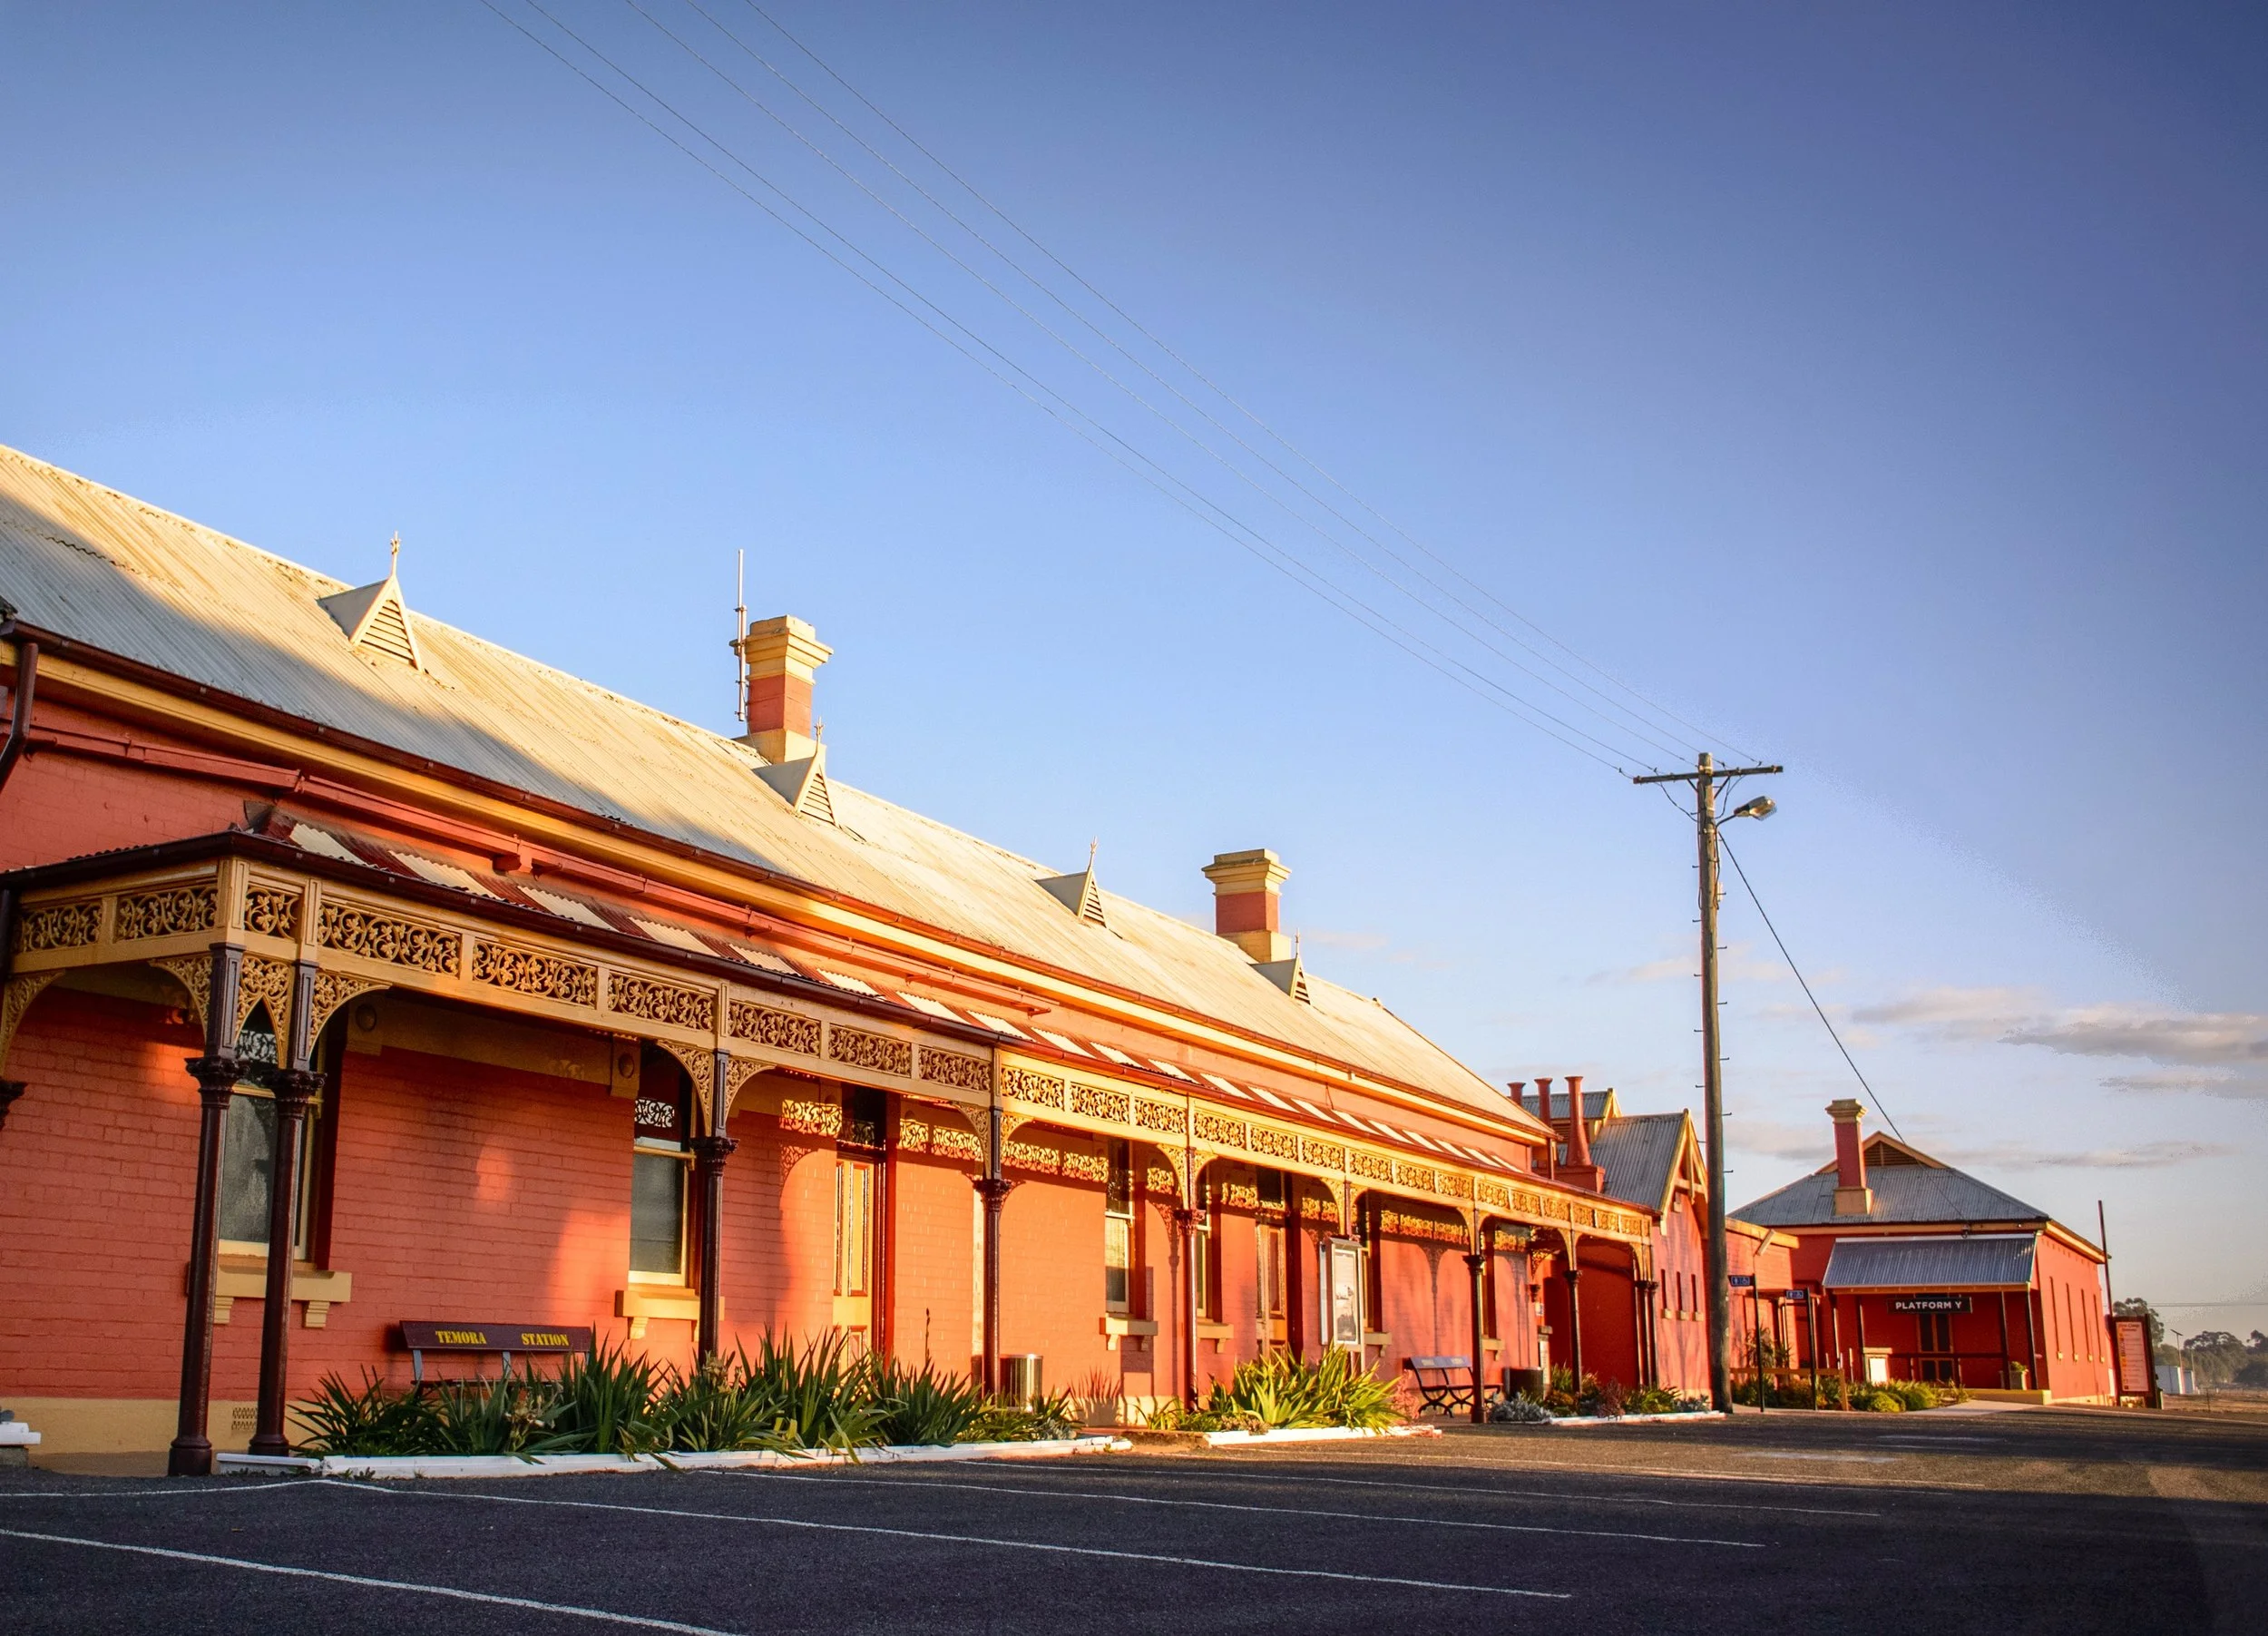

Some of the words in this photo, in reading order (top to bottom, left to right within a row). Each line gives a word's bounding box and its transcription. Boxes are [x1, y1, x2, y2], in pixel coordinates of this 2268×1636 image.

[1895, 1301, 1951, 1309] PLATFORM
[435, 1330, 487, 1345] TEMORA
[521, 1333, 570, 1347] STATION
